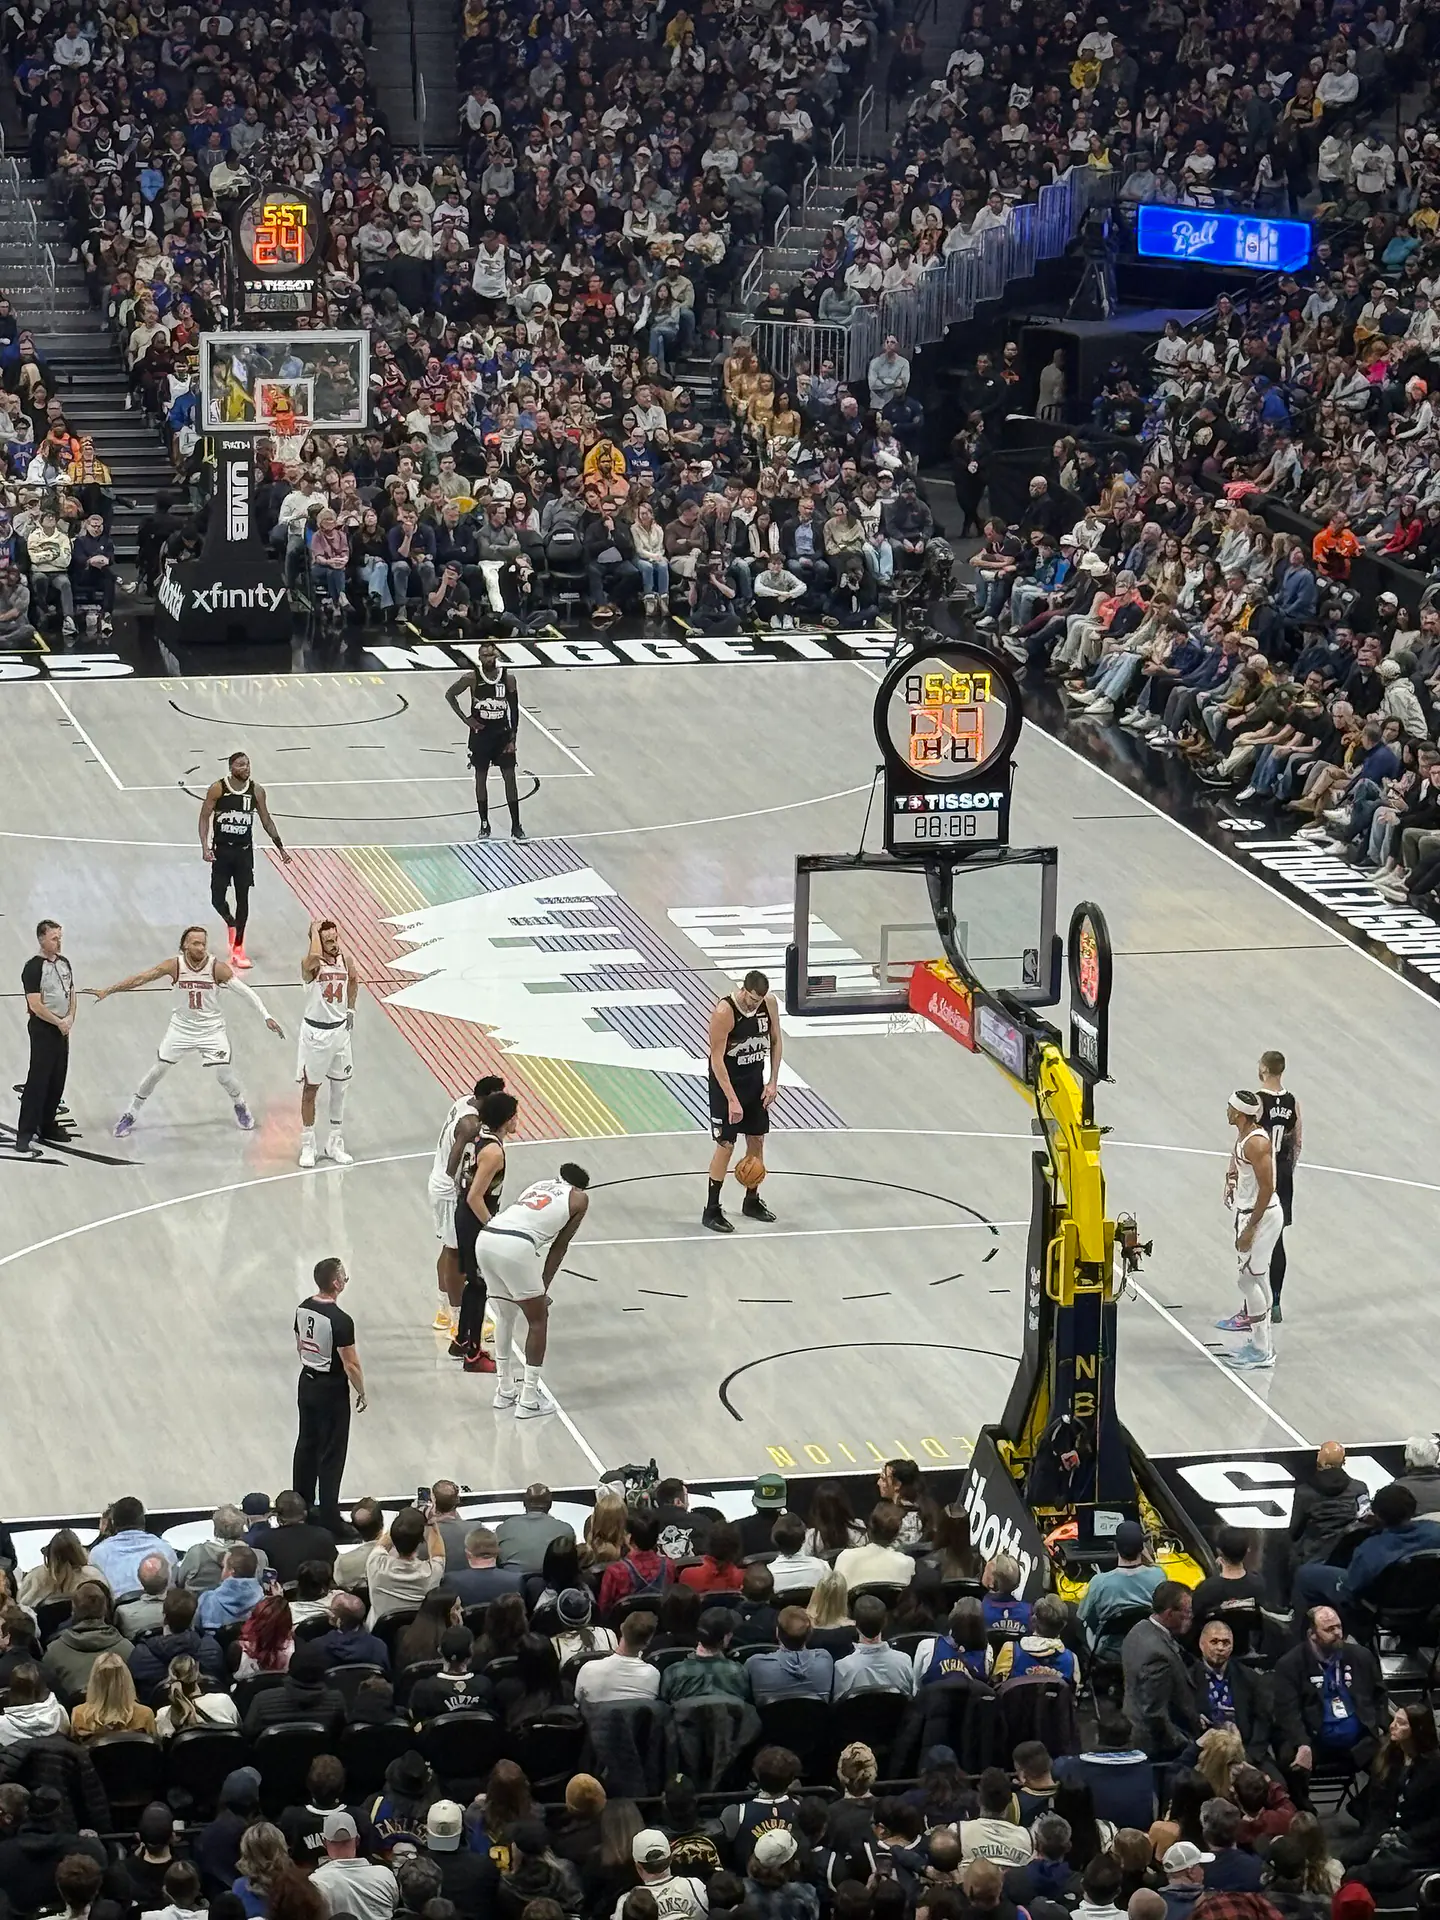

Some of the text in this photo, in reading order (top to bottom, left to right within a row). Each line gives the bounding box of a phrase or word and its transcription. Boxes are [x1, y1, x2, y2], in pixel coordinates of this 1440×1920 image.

[263, 204, 307, 226] 5:57
[253, 225, 305, 264] 24
[1172, 220, 1218, 254] Ball
[231, 461, 249, 541] UMB
[191, 582, 288, 613] xfinity
[362, 633, 912, 671] NUGGETS
[924, 672, 992, 706] 5:57
[908, 706, 985, 767] 24
[924, 792, 1004, 810] TISSOT
[321, 981, 344, 1004] 44
[757, 1016, 769, 1033] 15
[765, 1436, 976, 1468] EDITION
